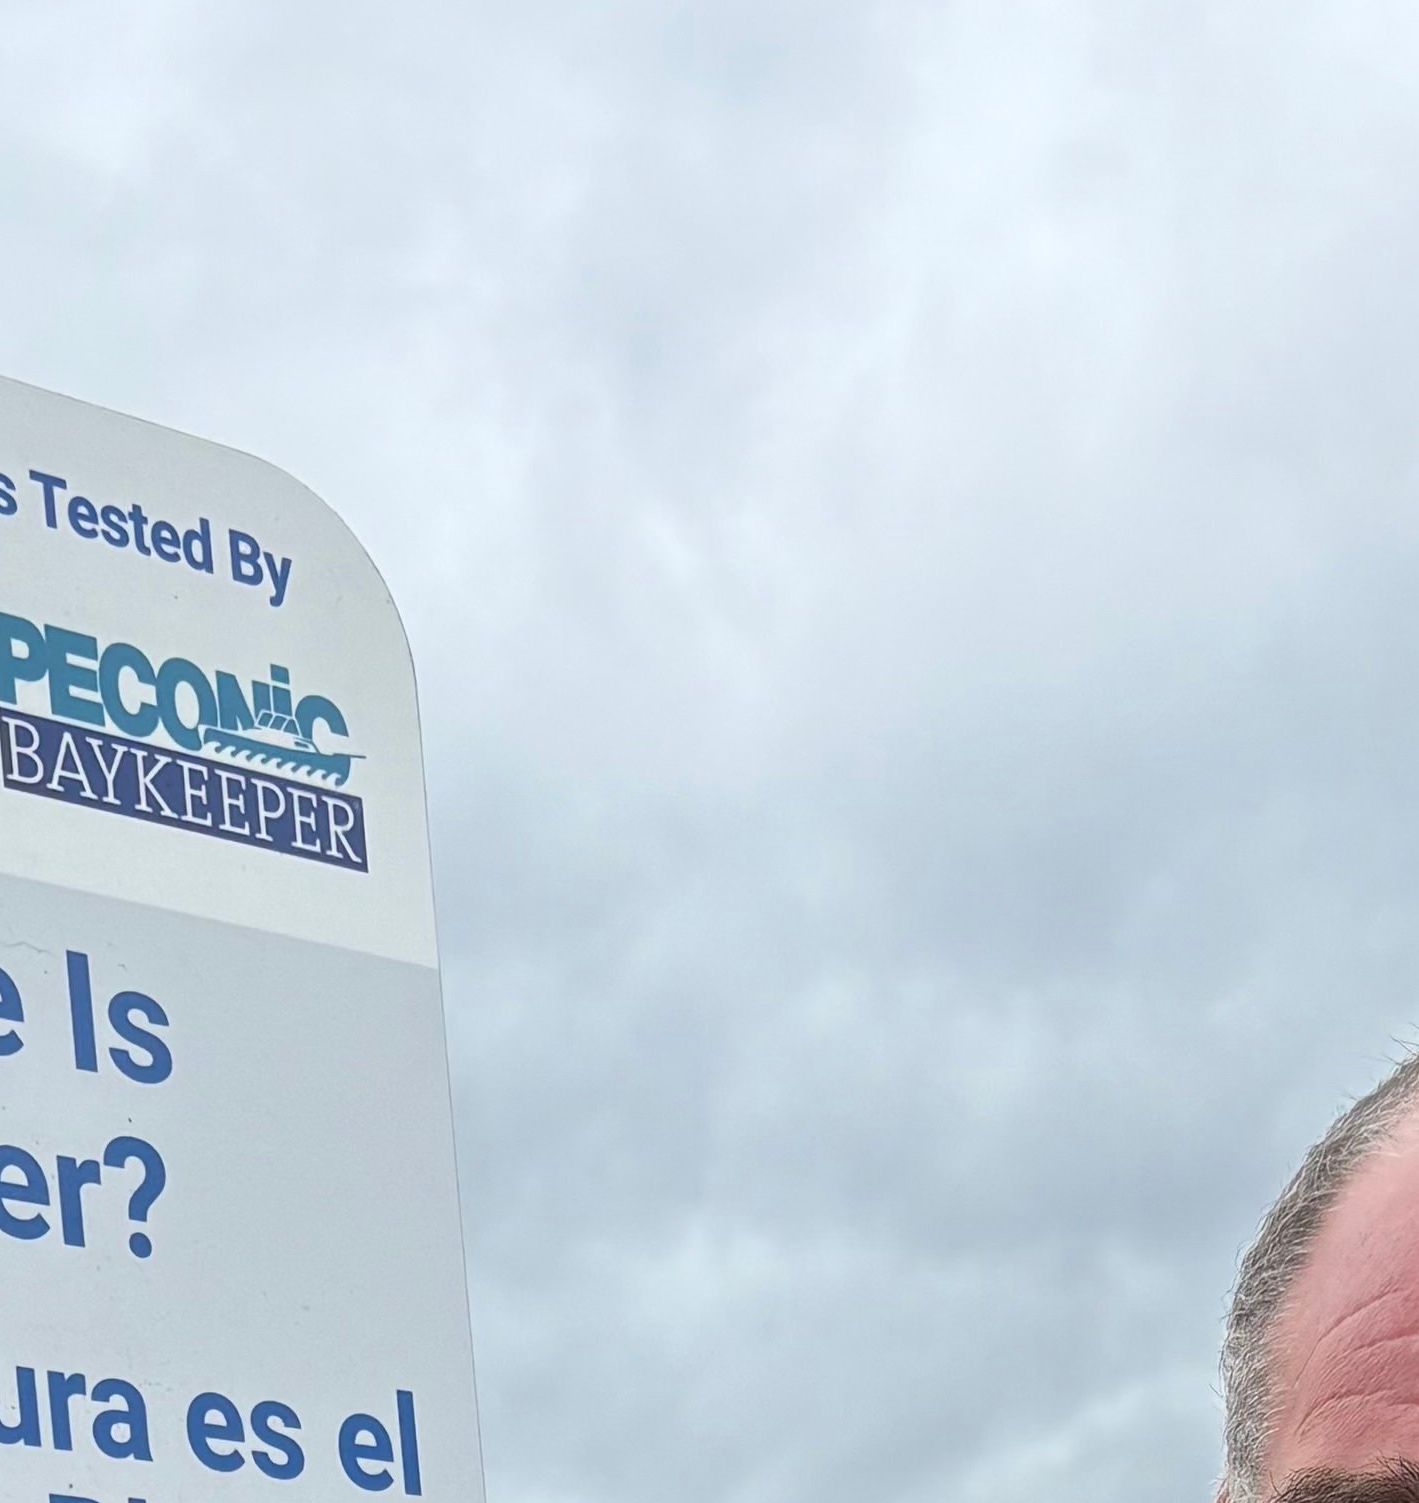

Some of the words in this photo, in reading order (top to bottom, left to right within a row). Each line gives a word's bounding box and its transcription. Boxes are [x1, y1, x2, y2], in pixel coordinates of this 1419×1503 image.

[31, 471, 212, 572] Tested
[229, 532, 290, 607] By
[2, 716, 362, 863] BAYKEEPER
[66, 951, 172, 1084] Is
[187, 1392, 305, 1480] es
[338, 1390, 421, 1495] el
